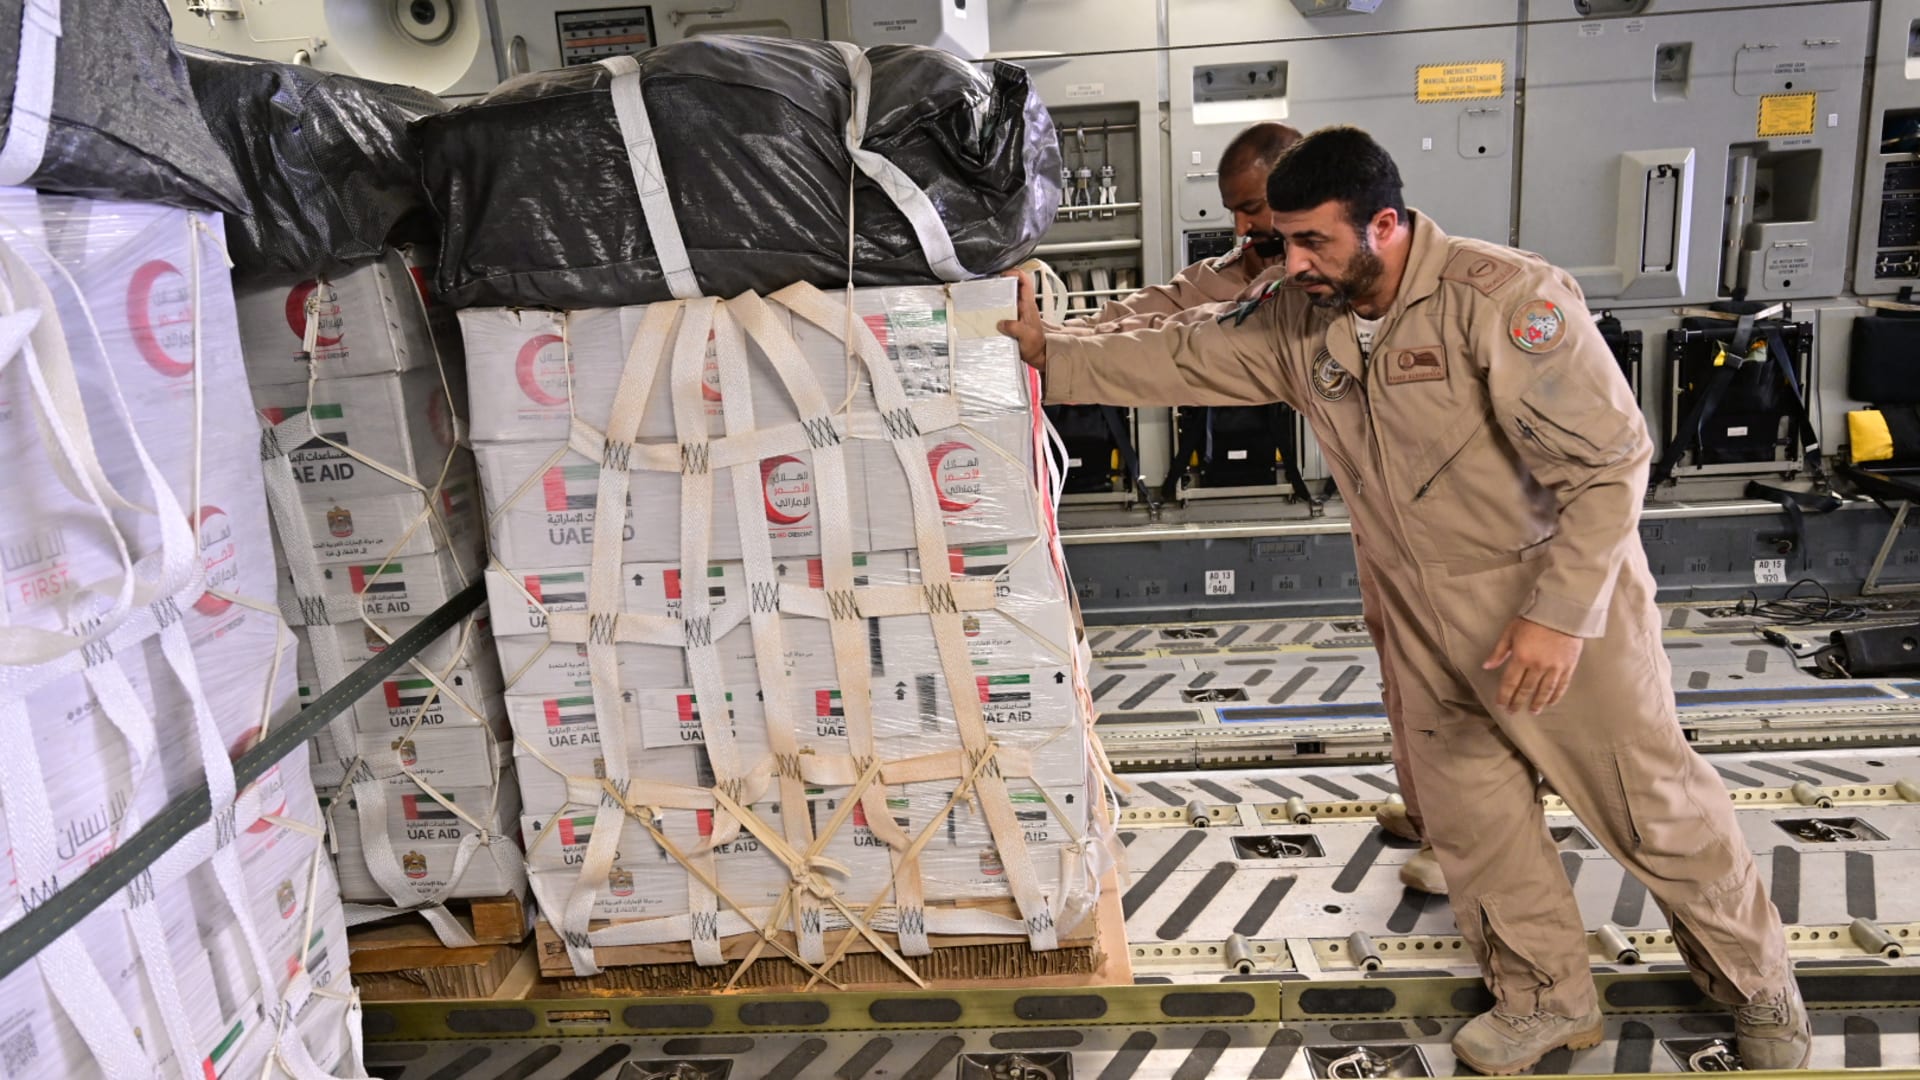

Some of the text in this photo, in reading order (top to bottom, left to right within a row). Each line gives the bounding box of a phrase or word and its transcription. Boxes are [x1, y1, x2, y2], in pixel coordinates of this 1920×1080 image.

[1443, 67, 1477, 76] EMERGENCY
[292, 463, 355, 484] AE AID
[548, 527, 594, 545] UAE
[1759, 560, 1782, 569] AD 15
[1222, 571, 1231, 580] 13
[20, 569, 69, 605] FIRST
[994, 585, 1012, 597] ID
[1212, 584, 1228, 593] 840
[387, 601, 410, 613] AID
[529, 615, 548, 628] UA
[420, 714, 444, 726] AID
[1008, 711, 1032, 723] AID
[680, 730, 705, 741] UA
[817, 726, 846, 737] UAE
[548, 734, 578, 748] UAE
[407, 828, 461, 841] UAE AID
[1024, 831, 1049, 842] AID
[713, 841, 759, 854] AE AID
[564, 854, 585, 865] UA
